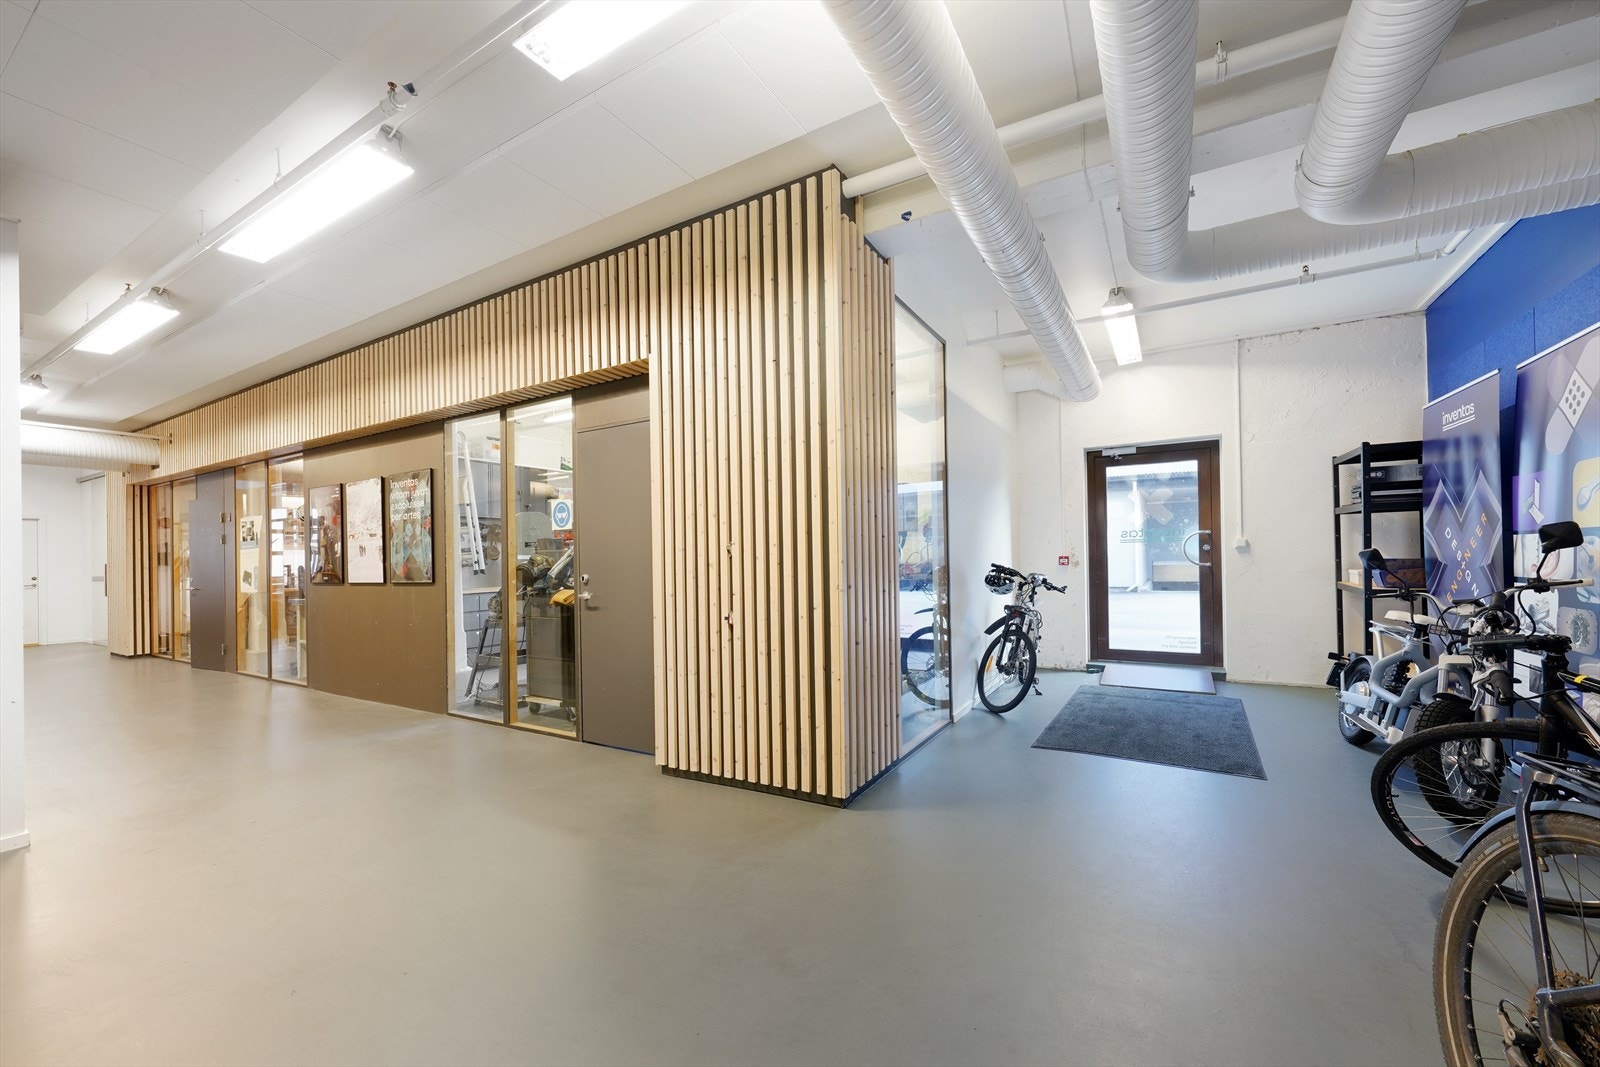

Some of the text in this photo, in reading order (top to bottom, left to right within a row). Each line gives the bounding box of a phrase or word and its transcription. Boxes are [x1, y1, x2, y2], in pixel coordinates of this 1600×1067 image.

[1442, 403, 1475, 425] inventas
[390, 478, 419, 489] inventas
[403, 511, 421, 520] artes
